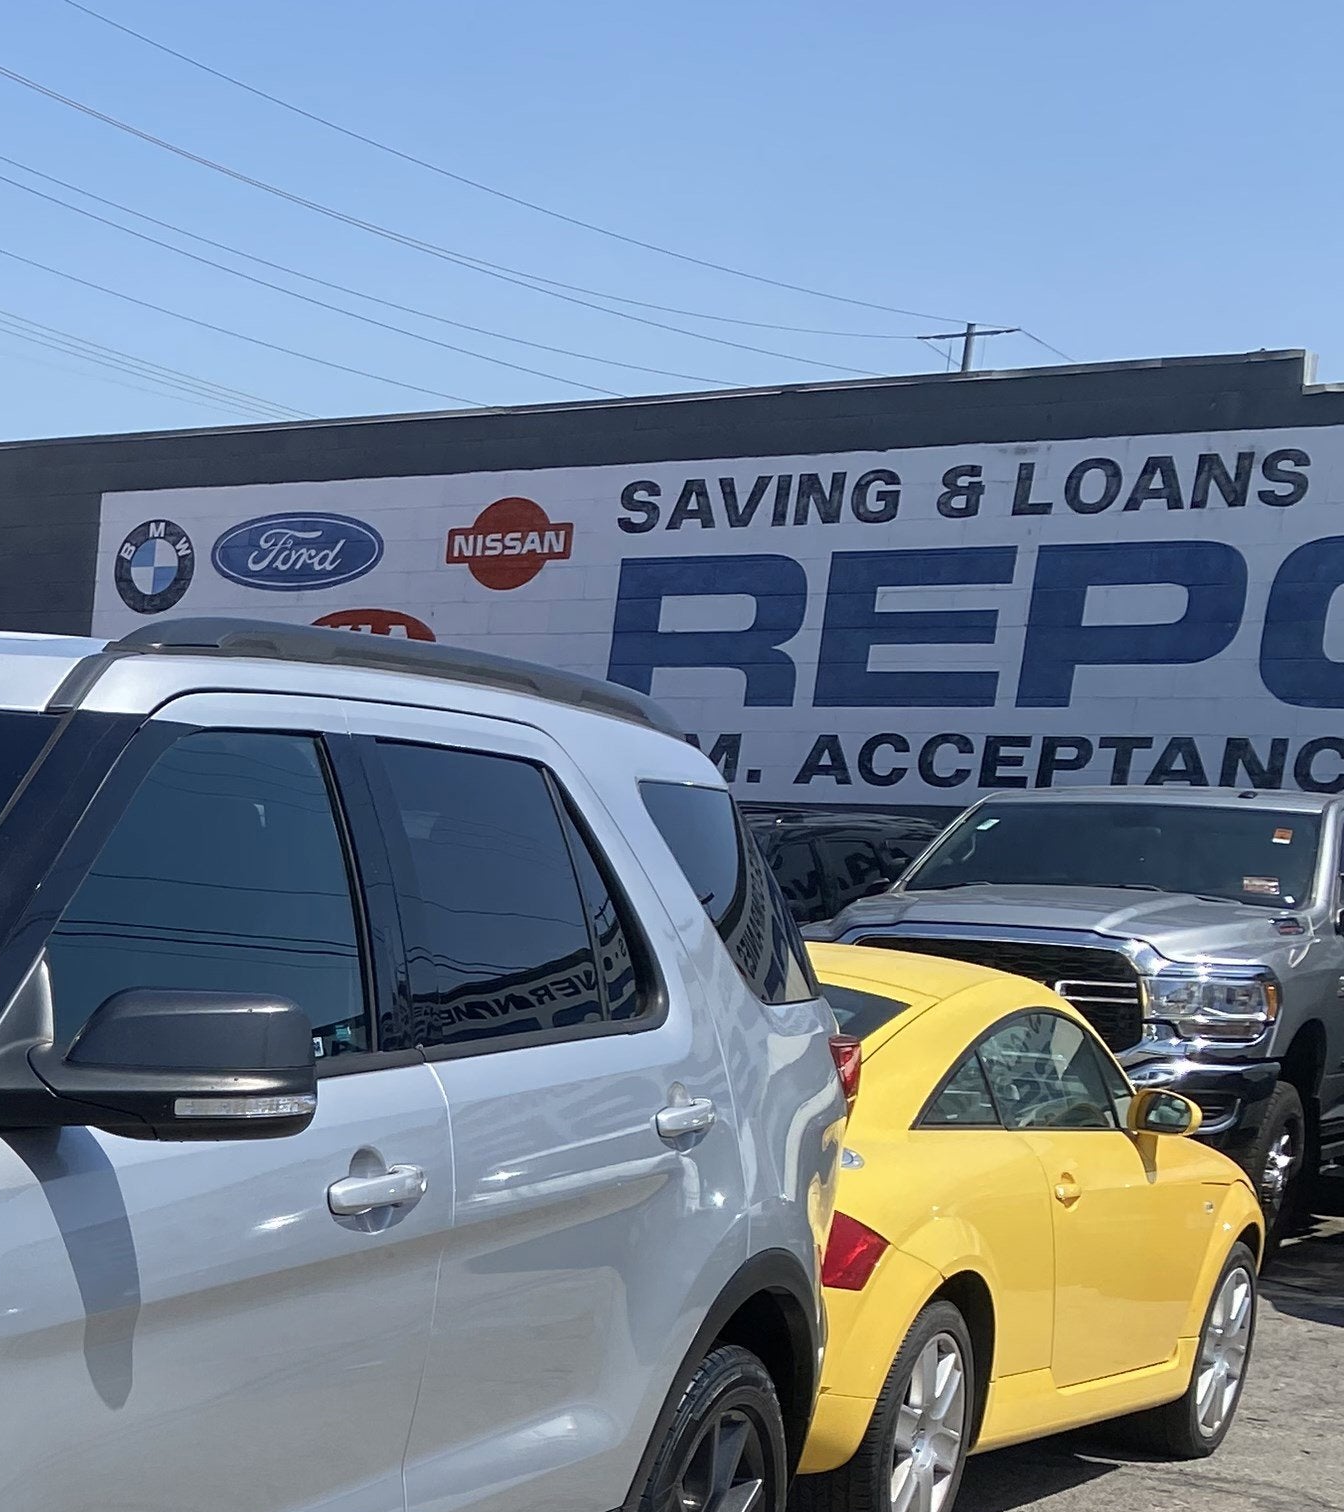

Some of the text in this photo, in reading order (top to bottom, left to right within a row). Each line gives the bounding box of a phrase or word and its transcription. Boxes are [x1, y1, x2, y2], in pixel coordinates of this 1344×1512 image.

[617, 448, 1311, 534] SAVING & LOANS
[119, 521, 193, 561] BMW
[247, 528, 346, 572] Ford
[452, 530, 567, 558] NISSAN
